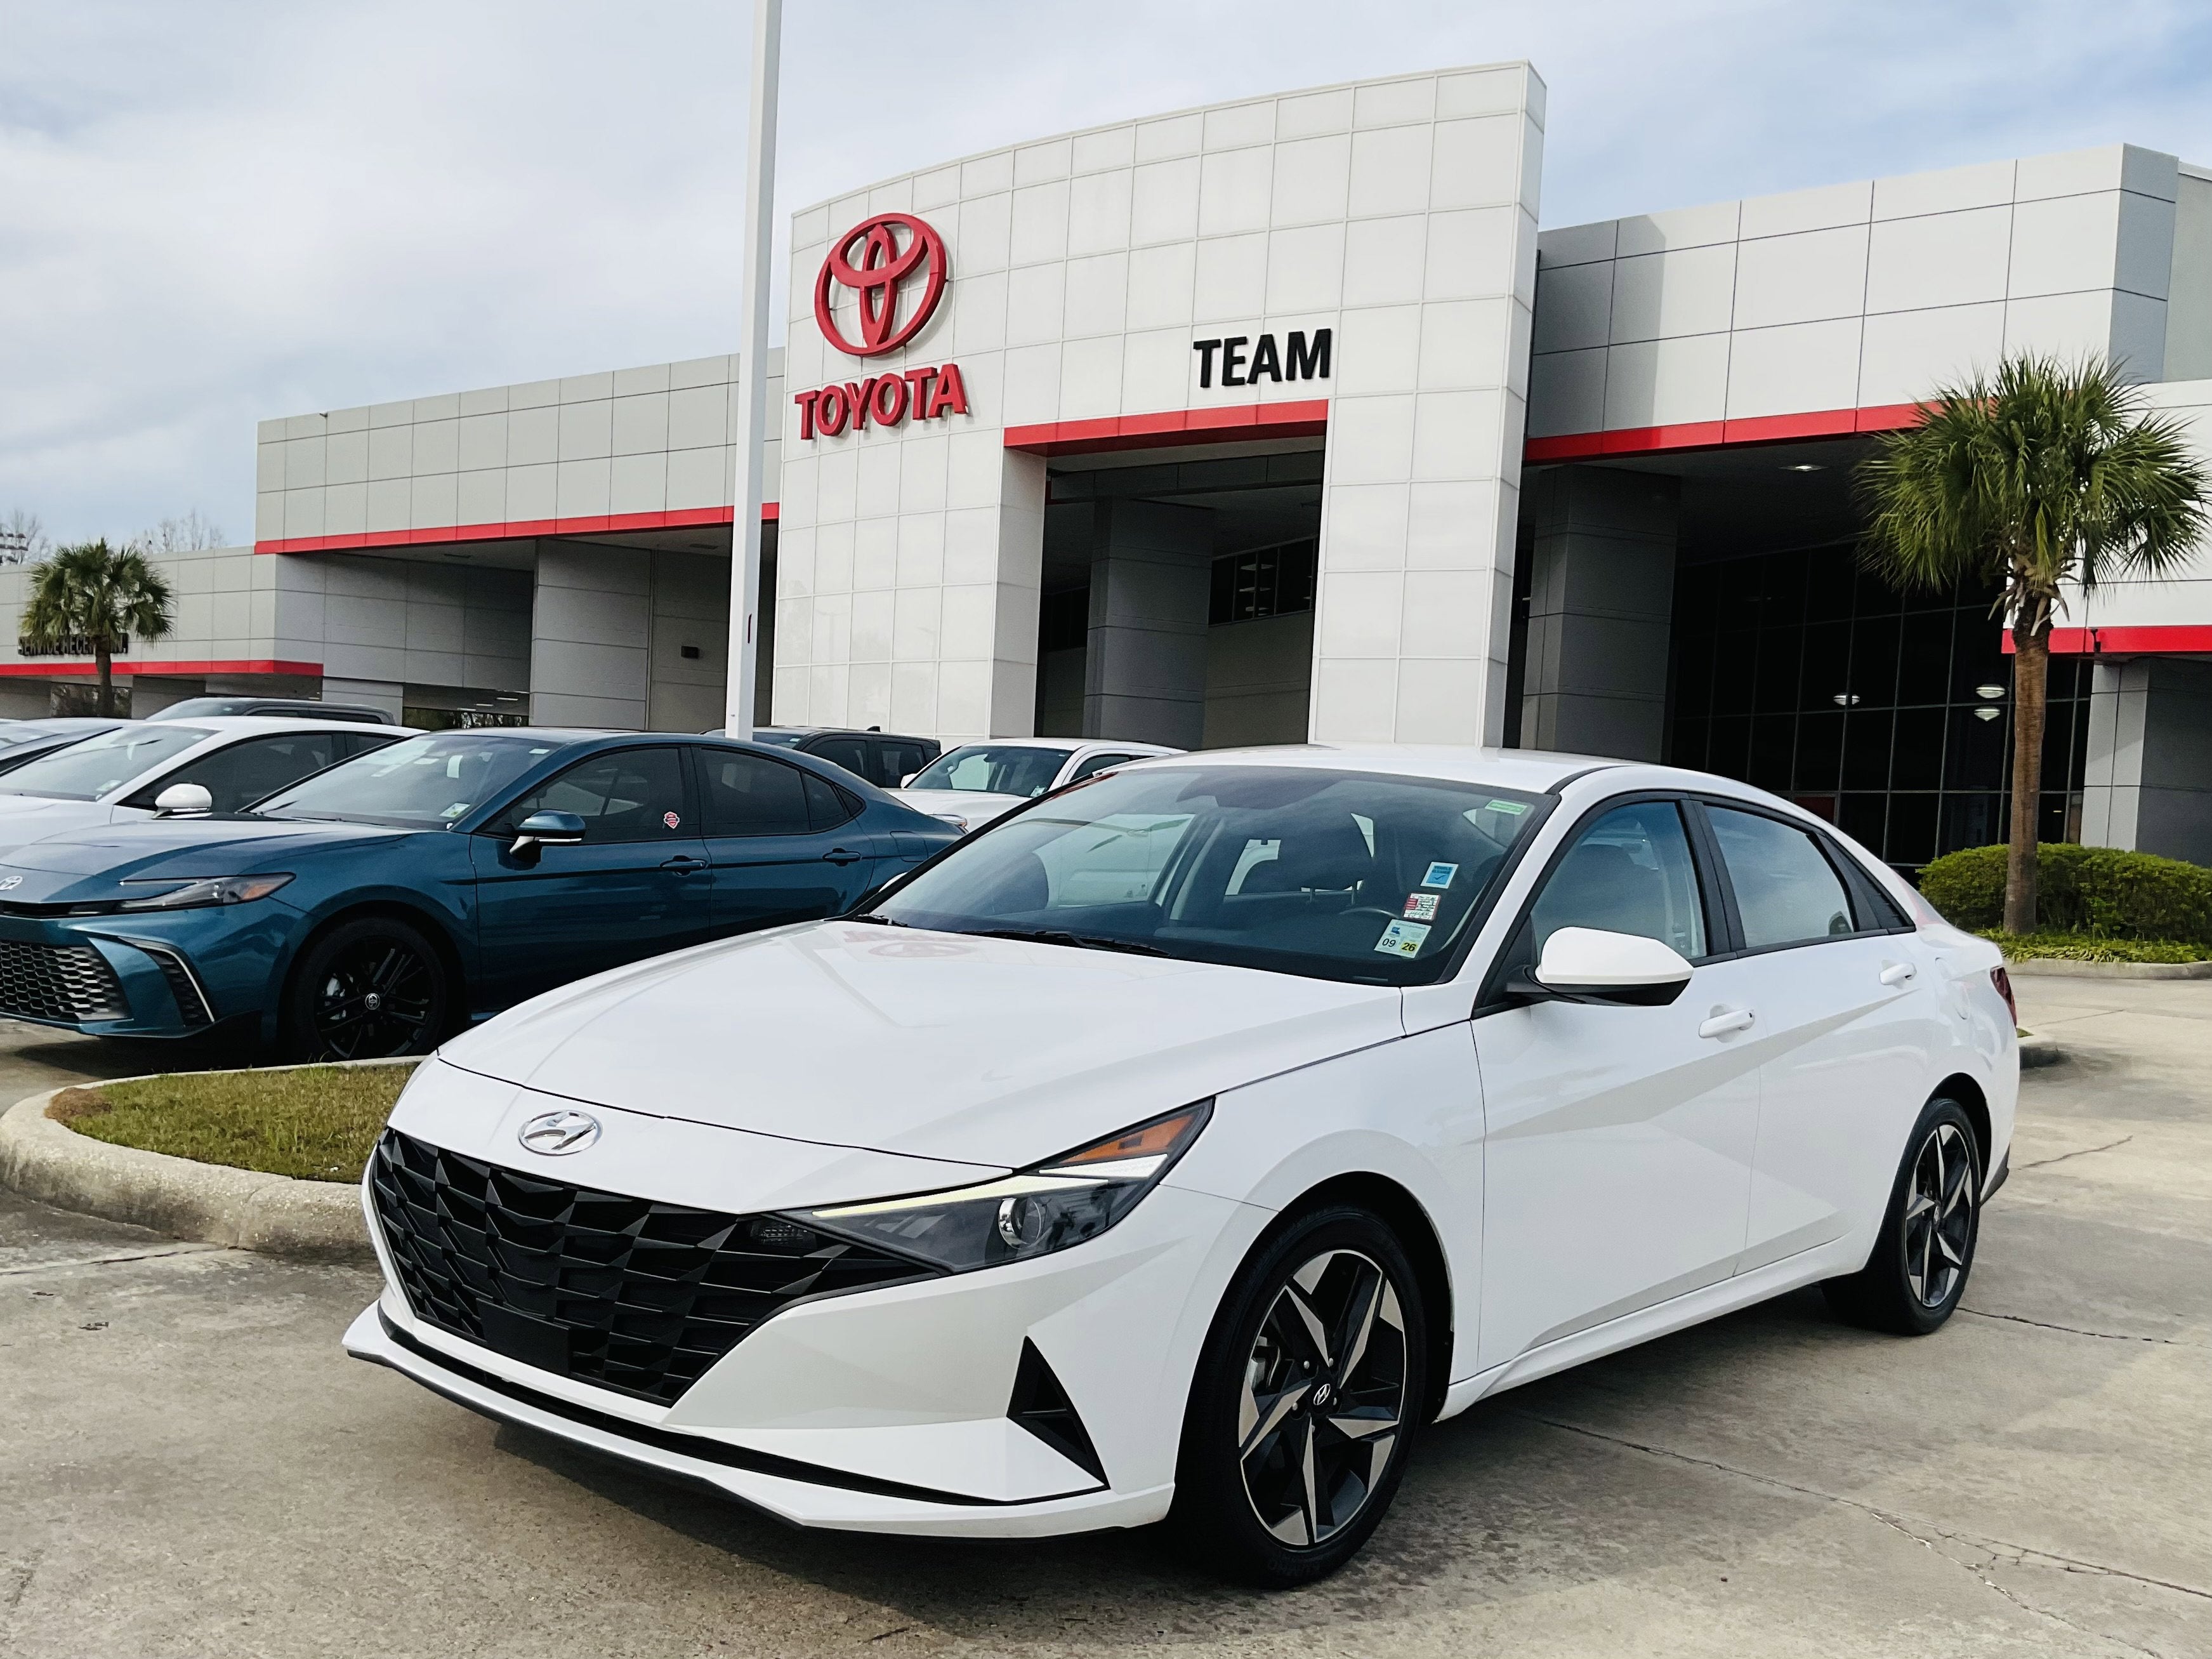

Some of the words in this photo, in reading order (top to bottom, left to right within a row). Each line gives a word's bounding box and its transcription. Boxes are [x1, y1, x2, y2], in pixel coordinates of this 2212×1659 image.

[1193, 328, 1331, 388] TEAM
[795, 363, 968, 440] TOYOTA
[61, 633, 129, 655] RECEN
[1382, 938, 1397, 948] 09
[1401, 942, 1417, 952] 26
